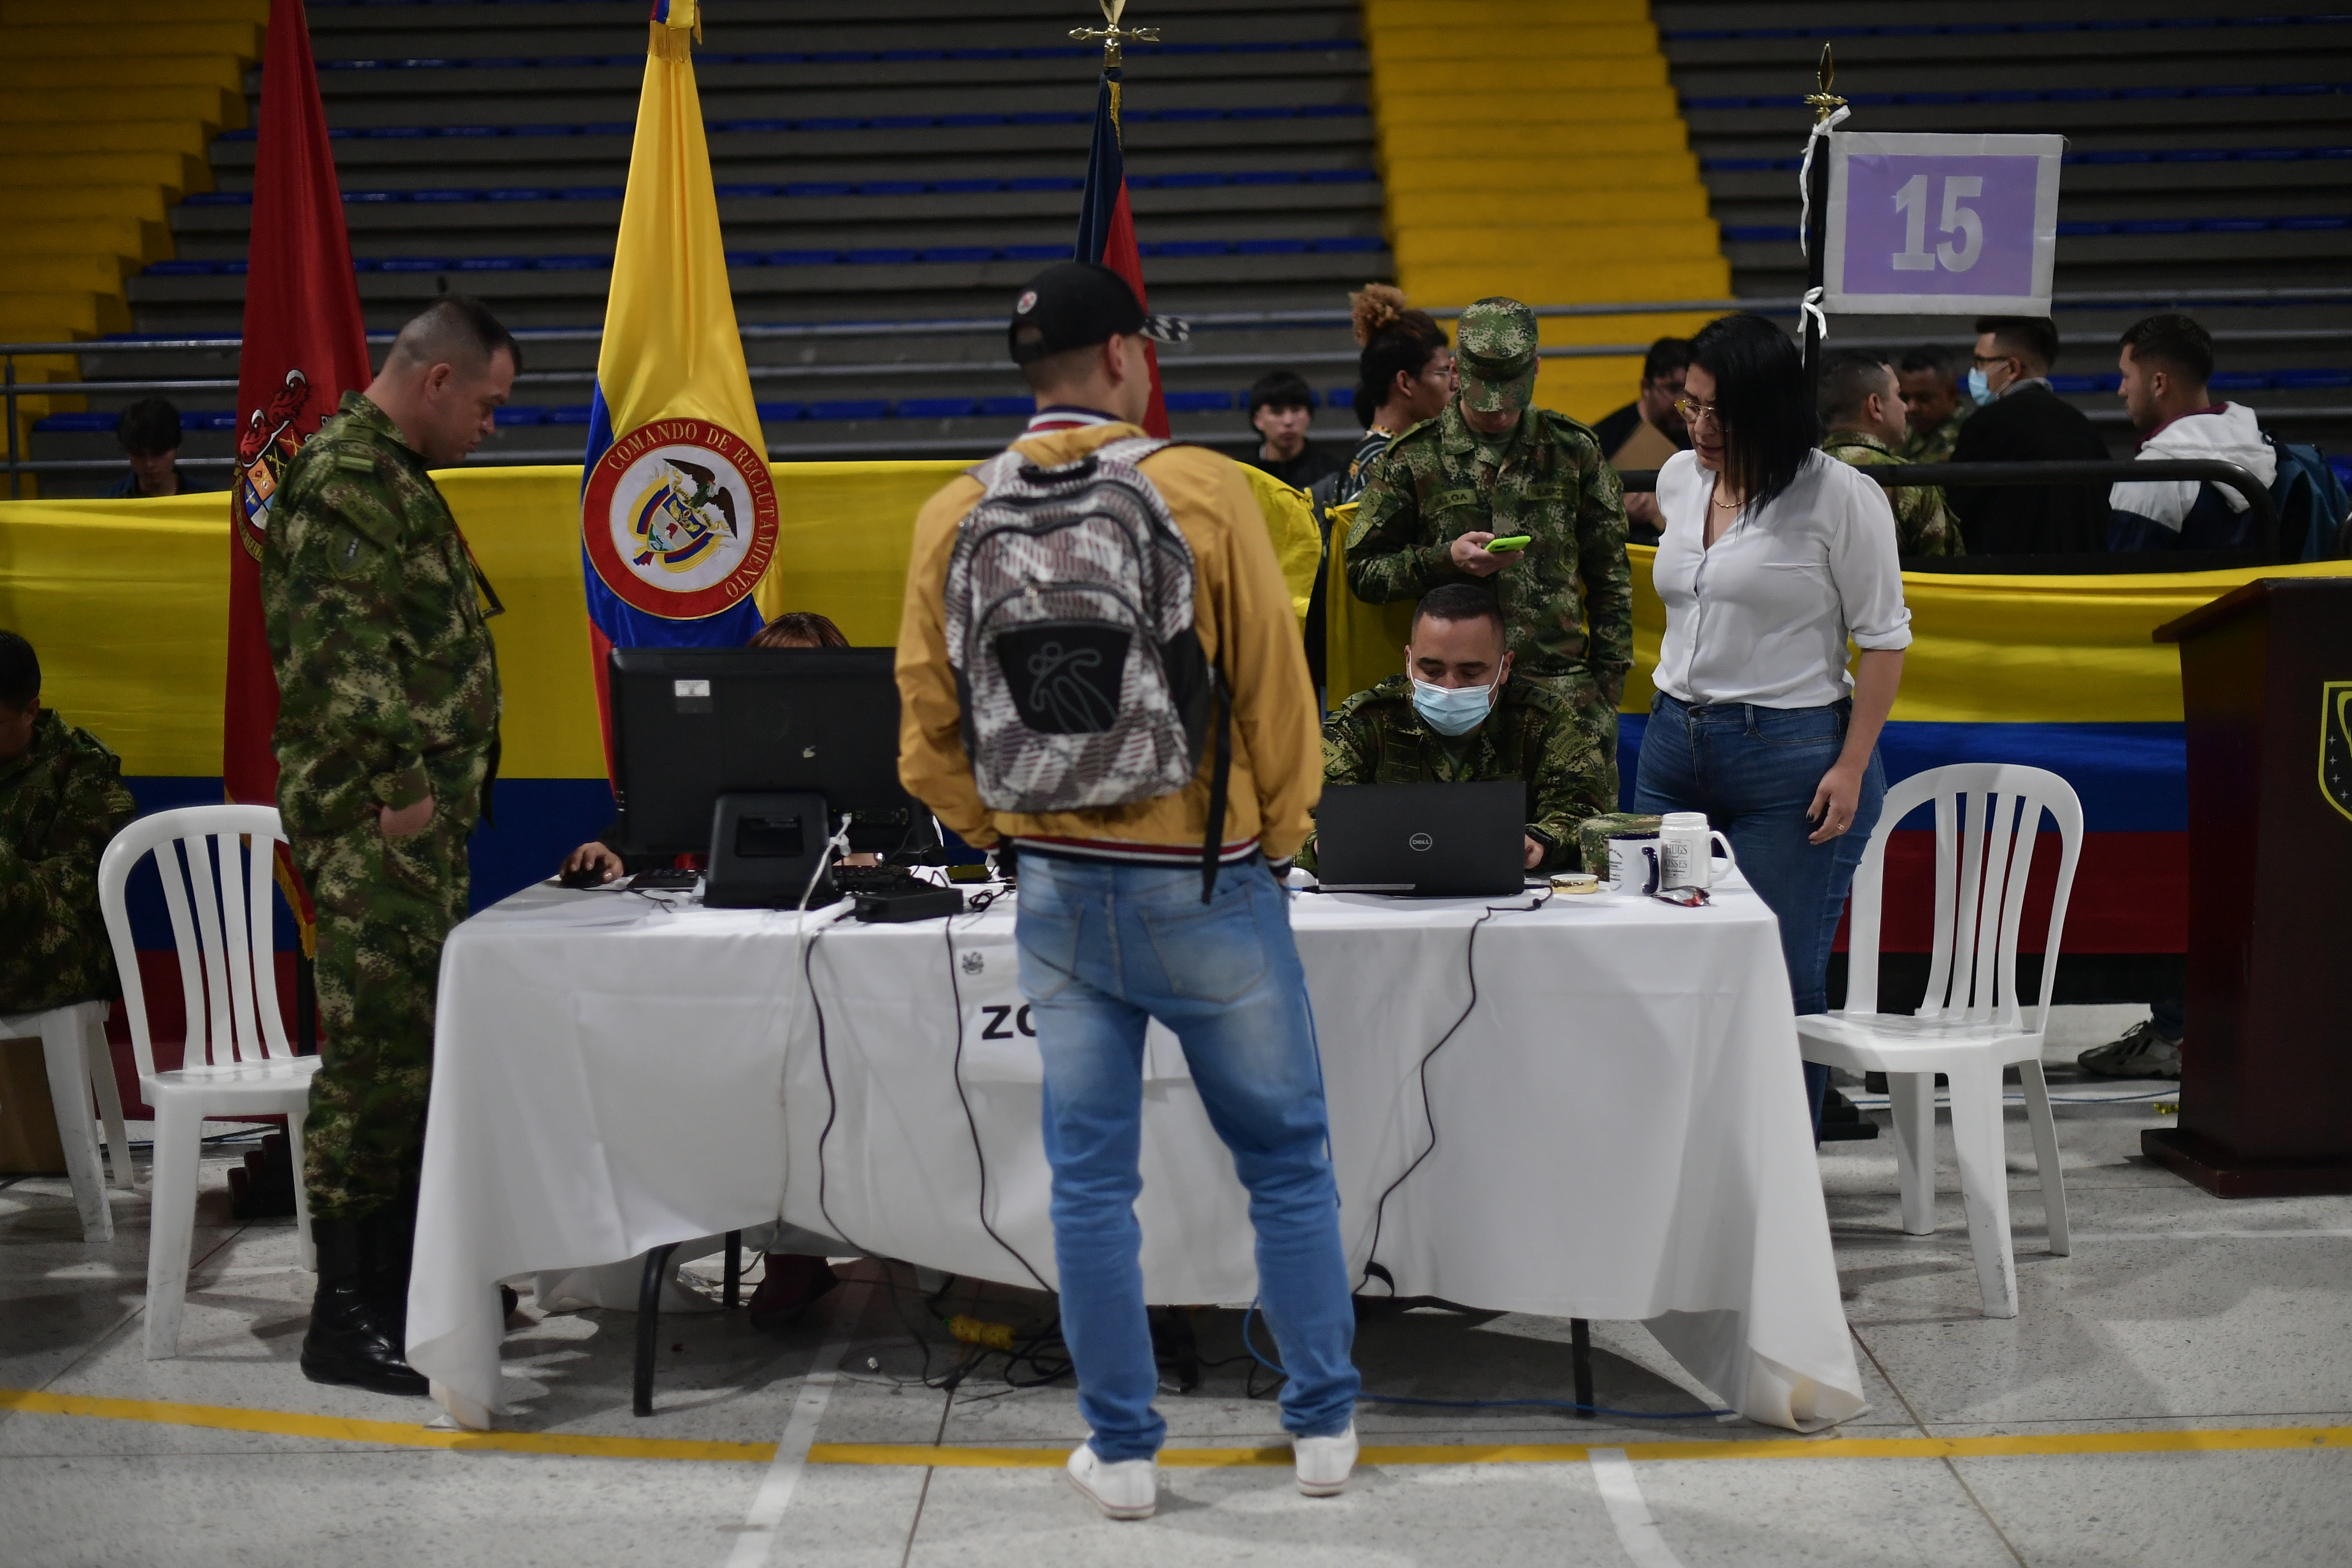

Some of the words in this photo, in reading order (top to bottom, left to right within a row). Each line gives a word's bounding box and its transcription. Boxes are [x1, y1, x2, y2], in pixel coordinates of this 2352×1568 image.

[1893, 174, 1983, 272] 15
[608, 422, 697, 470] COMANDO
[706, 427, 732, 452] DE
[725, 447, 776, 598] RECLUTAMIENTO
[1664, 858, 1688, 868] KISSES
[1666, 844, 1688, 855] HUGS
